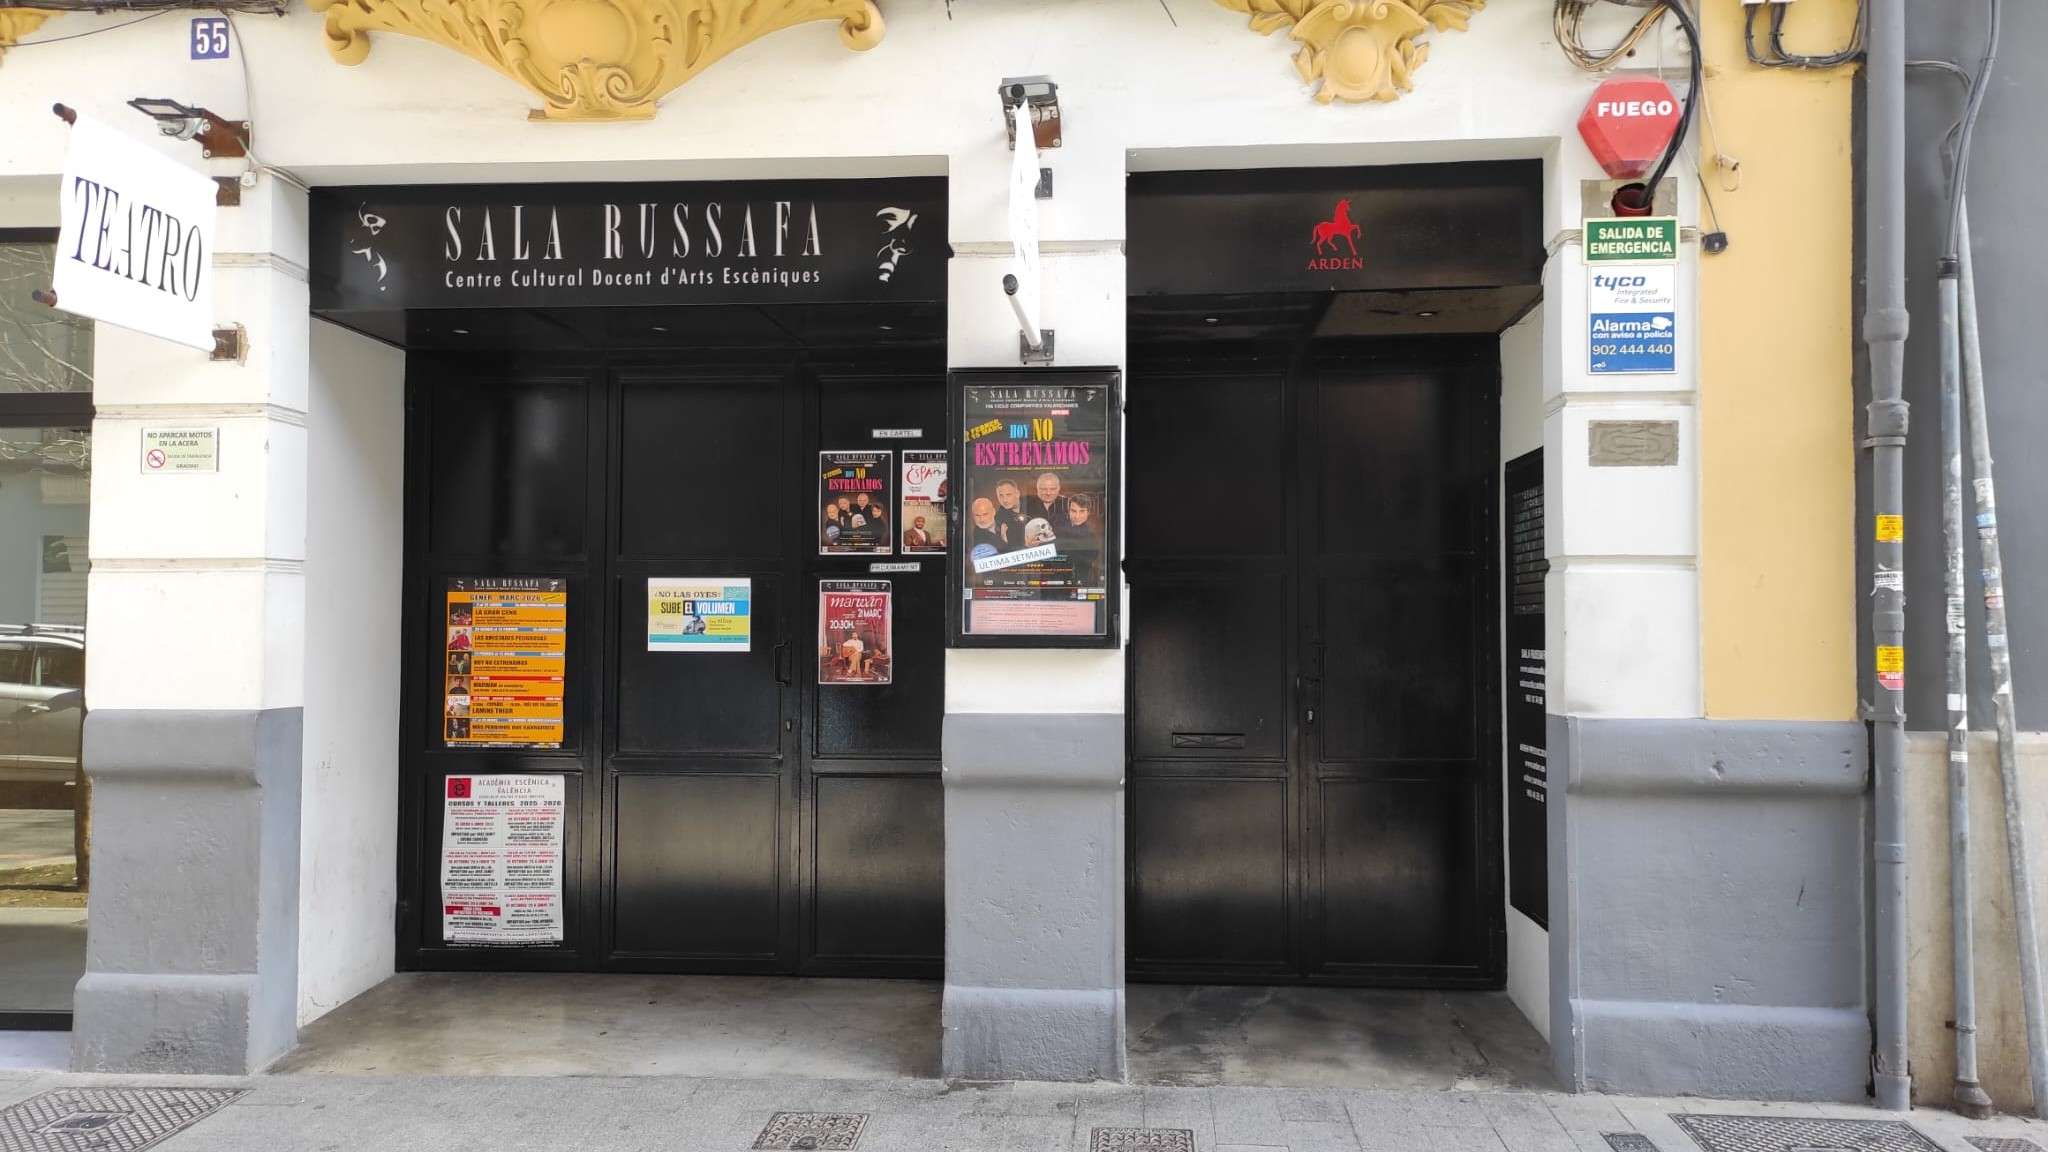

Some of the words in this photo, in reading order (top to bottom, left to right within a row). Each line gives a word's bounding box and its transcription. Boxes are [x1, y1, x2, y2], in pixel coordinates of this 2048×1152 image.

[196, 23, 227, 54] 55
[1598, 101, 1672, 117] FUEGO
[445, 205, 563, 261] SALA
[603, 200, 823, 259] RUSSAFA
[1598, 228, 1644, 239] SALIDA
[1647, 227, 1663, 238] DE
[71, 176, 201, 302] TEATRO
[1590, 241, 1672, 254] EMERGENCIA
[1308, 258, 1363, 270] ARDEN
[445, 271, 501, 288] Centre
[511, 268, 583, 287] Cultural
[593, 268, 651, 286] Docent
[661, 267, 713, 285] d'Arts
[724, 266, 821, 287] Escèniques
[1593, 275, 1646, 291] tyco
[1617, 288, 1658, 296] Integrated
[1593, 319, 1651, 331] Alarma
[1592, 345, 1616, 355] 902
[1619, 344, 1645, 355] 444
[1647, 344, 1672, 354] 440
[1010, 424, 1030, 439] HOY
[1032, 418, 1054, 441] NO
[975, 442, 1089, 466] ESTRENAMOS
[856, 467, 866, 479] NO
[828, 479, 883, 490] ESTRENAMOS
[1012, 547, 1052, 564] SETMANA
[661, 602, 682, 614] SUBE
[684, 602, 694, 614] EL
[696, 602, 736, 614] VOLUMEN
